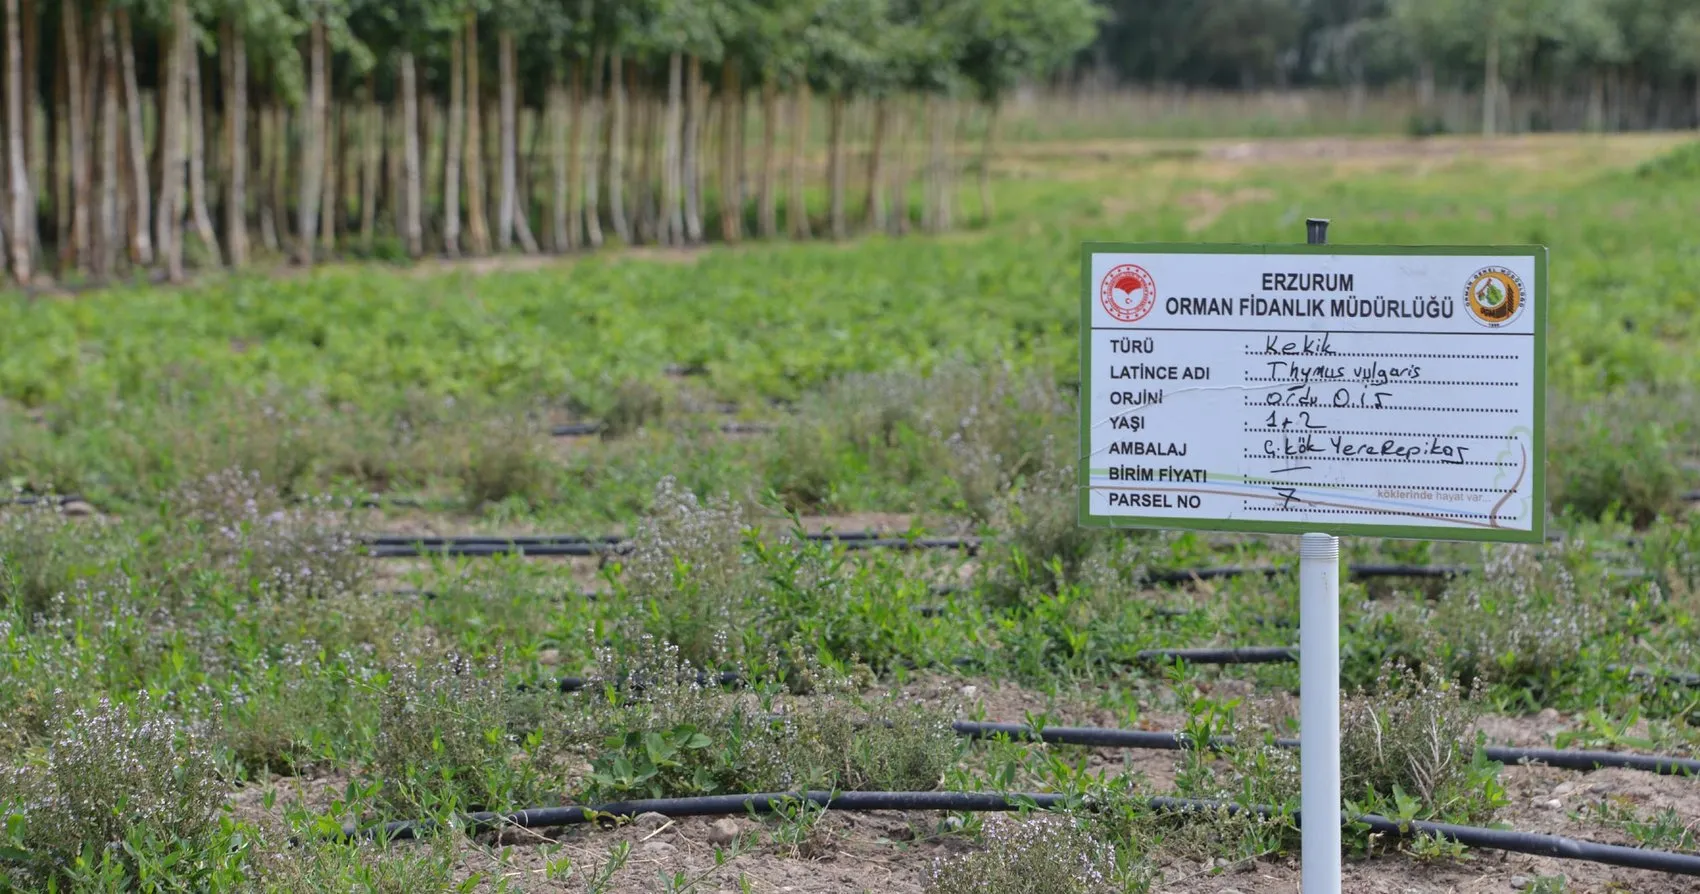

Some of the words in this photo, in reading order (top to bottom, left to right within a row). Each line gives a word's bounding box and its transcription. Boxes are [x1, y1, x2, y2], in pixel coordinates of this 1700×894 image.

[1262, 273, 1354, 291] ERZURUM
[1166, 297, 1233, 315] ORMAN
[1240, 294, 1324, 316] FİDANLIK
[1330, 296, 1454, 318] MÜDÜRLÜĞÜ
[1111, 338, 1153, 353] TÜRÜ
[1266, 332, 1334, 354] Kekik
[1110, 363, 1178, 380] LATİNCE
[1182, 367, 1210, 380] ADI
[1268, 362, 1345, 389] Thymus
[1353, 362, 1421, 385] vulgaris
[1111, 390, 1163, 406] ORJİNİ
[1110, 416, 1145, 433] YAŞI
[1109, 442, 1187, 456] AMBALAJ
[1109, 464, 1154, 482] BİRİM
[1158, 466, 1207, 483] FİYATI
[1109, 493, 1172, 508] PARSEL
[1177, 495, 1201, 508] NO
[1271, 487, 1300, 508] 7
[1377, 488, 1433, 500] köklerinde
[1436, 491, 1466, 502] hayat
